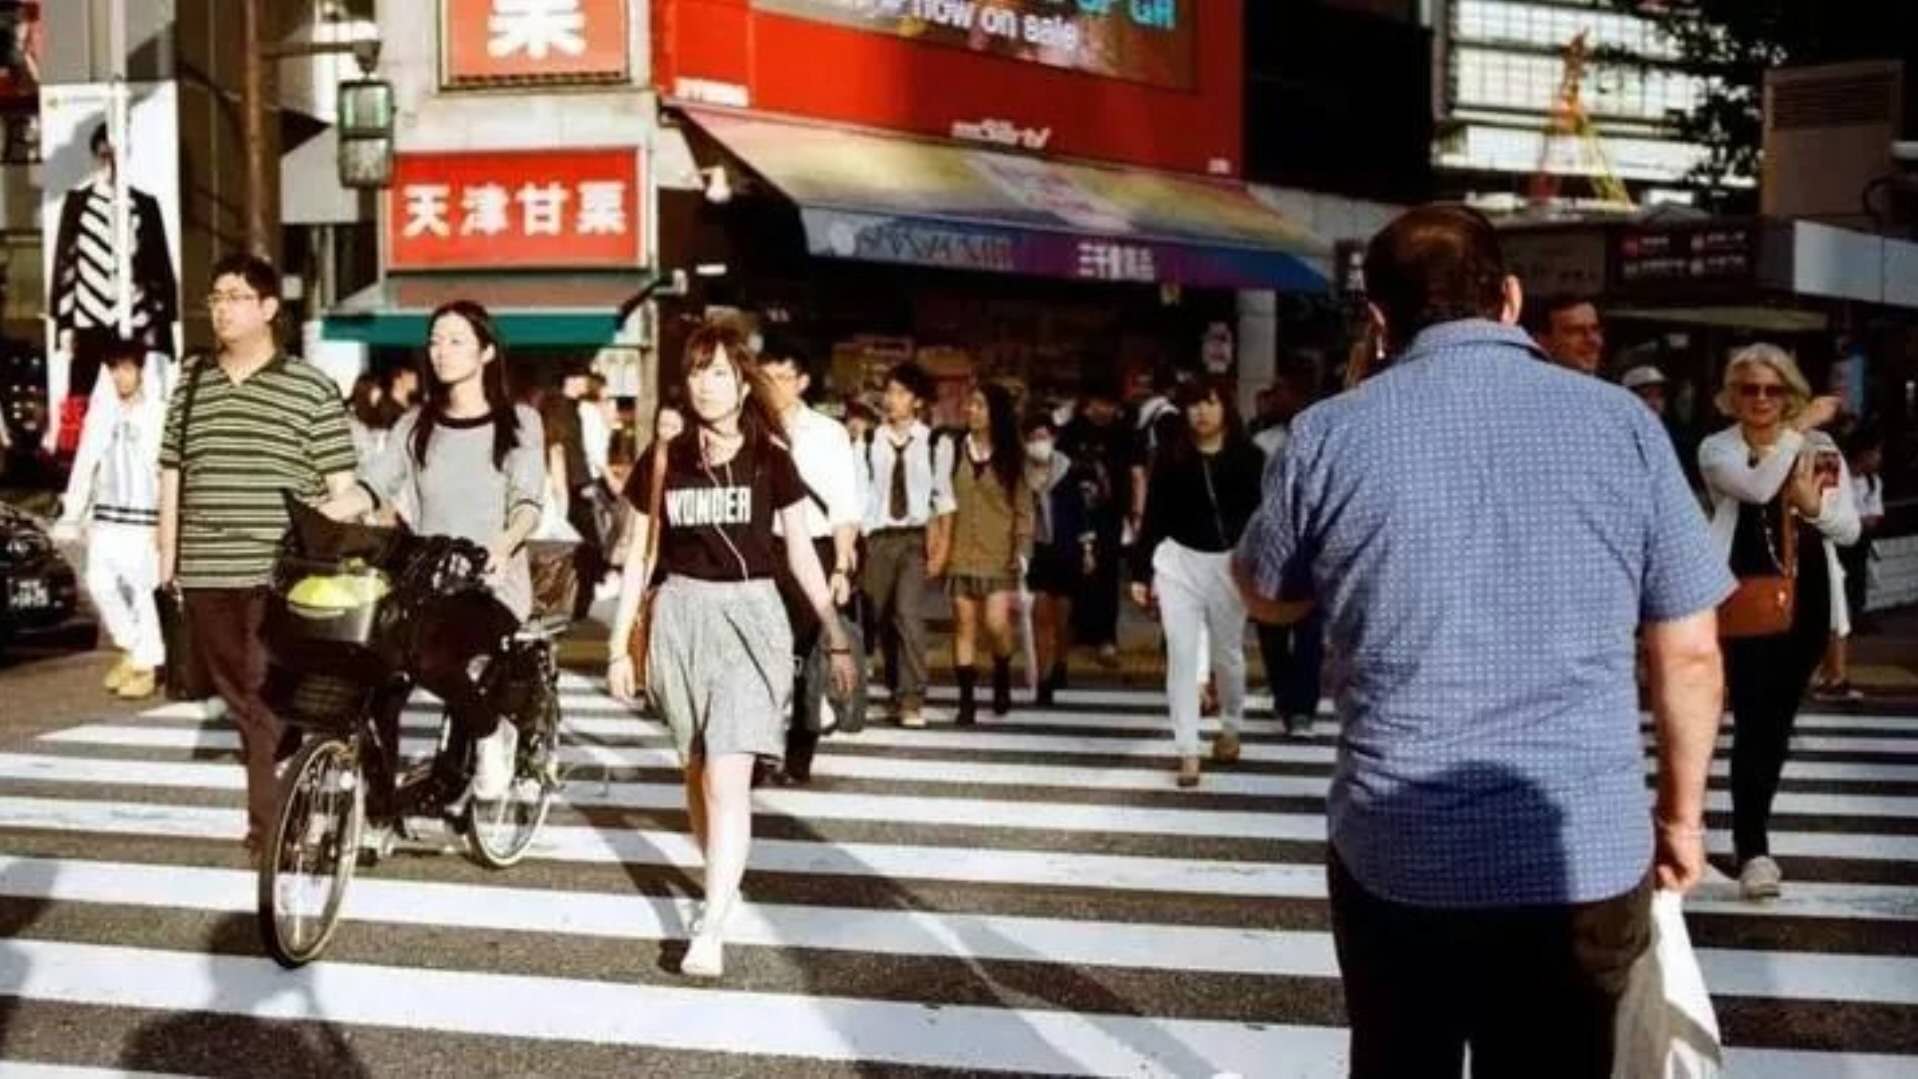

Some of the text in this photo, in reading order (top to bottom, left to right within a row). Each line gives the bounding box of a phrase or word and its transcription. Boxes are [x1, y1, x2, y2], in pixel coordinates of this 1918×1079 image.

[979, 6, 1018, 39] on
[1022, 15, 1079, 50] sale
[402, 181, 627, 238] 天津甘栗
[664, 486, 752, 528] WONDER
